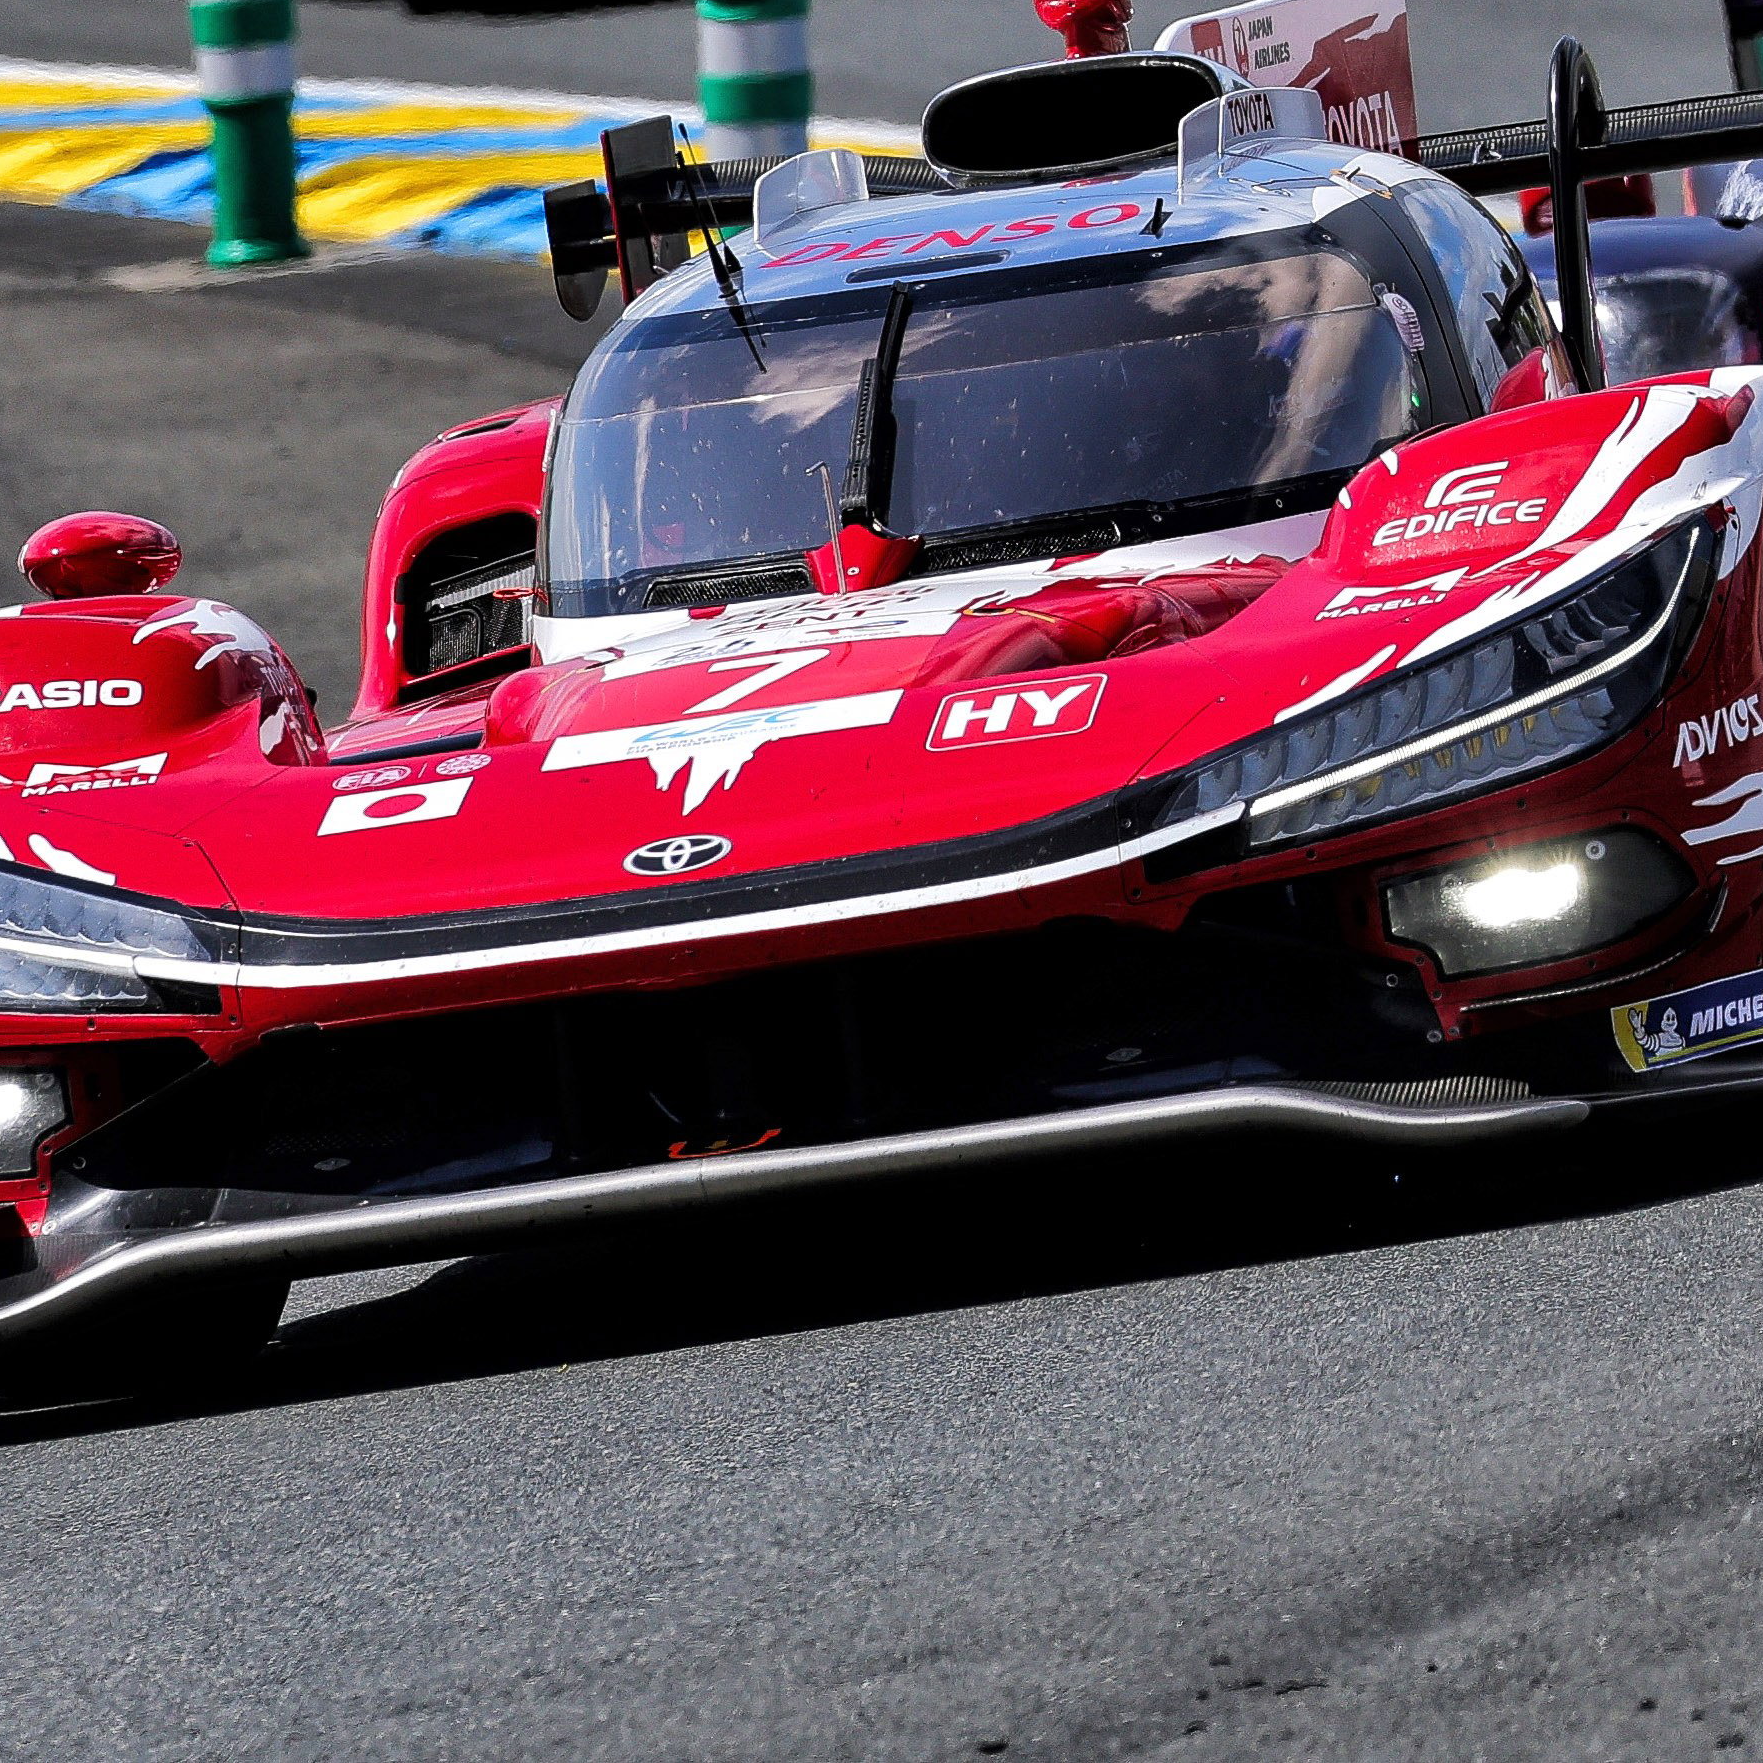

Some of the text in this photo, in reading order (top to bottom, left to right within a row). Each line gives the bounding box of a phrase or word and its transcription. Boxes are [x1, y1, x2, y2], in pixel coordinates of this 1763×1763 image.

[1248, 16, 1273, 41] JAPAN
[1254, 42, 1290, 69] AIRLINES
[1228, 93, 1274, 137] TOYOTA
[1325, 90, 1404, 157] OYOTA
[758, 203, 1141, 269] DENSO
[1372, 497, 1547, 547] EDIFICE
[1314, 592, 1447, 621] MARELLI
[682, 649, 831, 714] 7
[941, 683, 1092, 739] HY
[22, 775, 158, 798] MARELLI
